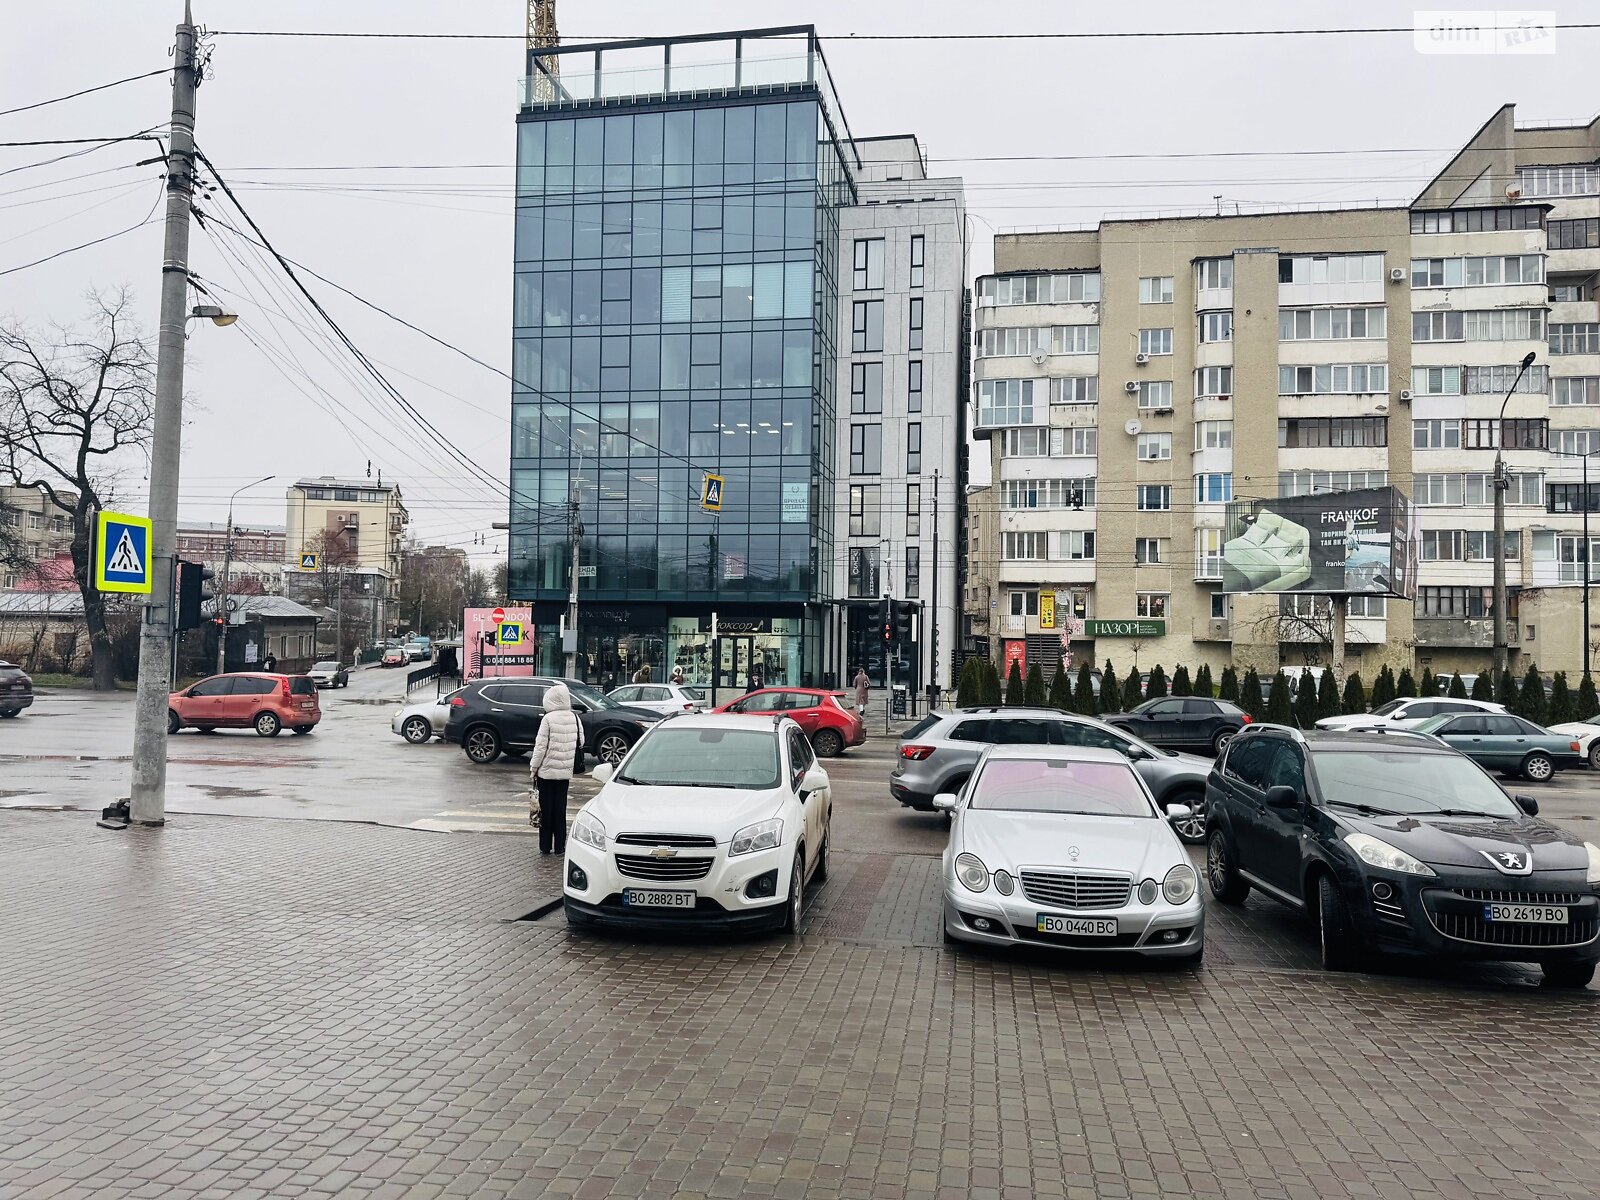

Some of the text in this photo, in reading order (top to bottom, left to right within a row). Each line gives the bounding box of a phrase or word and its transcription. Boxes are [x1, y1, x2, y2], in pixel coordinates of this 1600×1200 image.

[1321, 508, 1379, 523] FRANKOF
[630, 892, 645, 904] BO
[648, 893, 672, 905] 2882
[676, 894, 691, 905] BT
[1492, 907, 1563, 921] BO 2619 BO
[1045, 918, 1114, 934] BO 0440 BC
